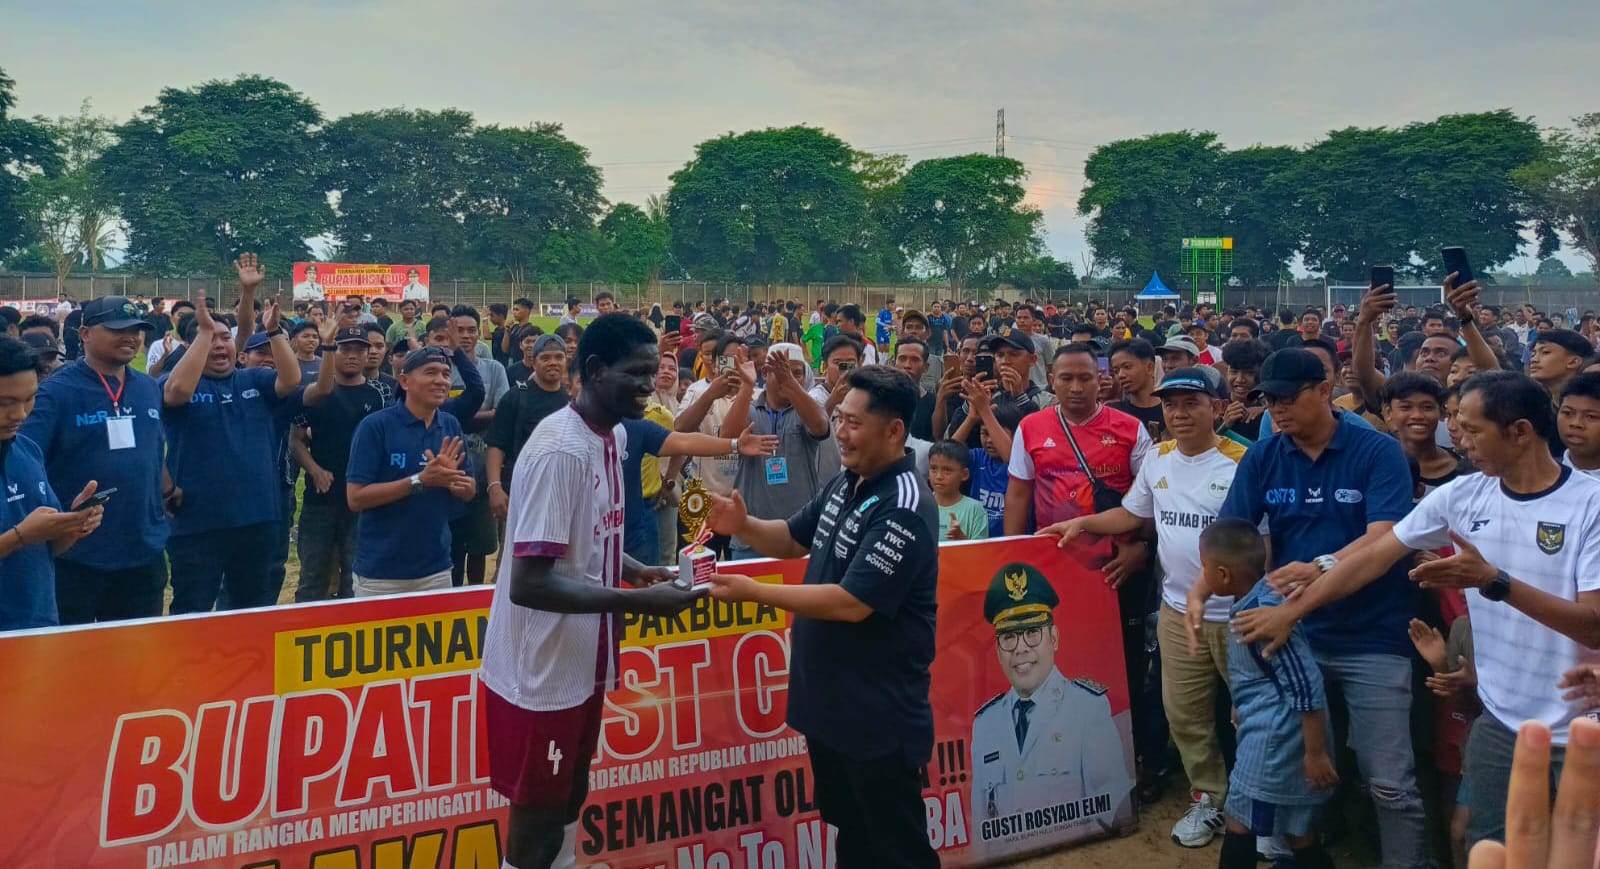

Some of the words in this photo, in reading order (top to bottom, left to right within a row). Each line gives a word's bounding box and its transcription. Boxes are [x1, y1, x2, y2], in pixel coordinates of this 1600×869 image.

[321, 273, 358, 285] BUPATI
[382, 273, 406, 285] CUP
[76, 411, 108, 427] NzR
[390, 453, 406, 468] Rj
[1266, 488, 1296, 504] CN73
[1160, 510, 1177, 526] PSSI
[1178, 512, 1199, 528] KAB
[873, 541, 896, 557] AMD
[884, 531, 906, 549] IWC
[295, 616, 489, 682] TOURNA
[621, 597, 777, 641] PAKBOLA
[590, 638, 711, 764] ST
[733, 627, 793, 738] C
[548, 740, 563, 775] 4
[147, 833, 227, 869] DALAM
[233, 817, 323, 855] RANGKA
[329, 790, 481, 838] MEMPERINGATI
[486, 787, 511, 810] HA
[588, 759, 664, 792] RDEKAAN
[668, 744, 746, 778] REPUBLIK
[750, 735, 809, 762] INDONE
[582, 775, 764, 856] SEMANGAT
[982, 814, 1023, 840] GUSTI
[1025, 801, 1080, 830] ROSYADI
[1082, 793, 1111, 817] ELMI
